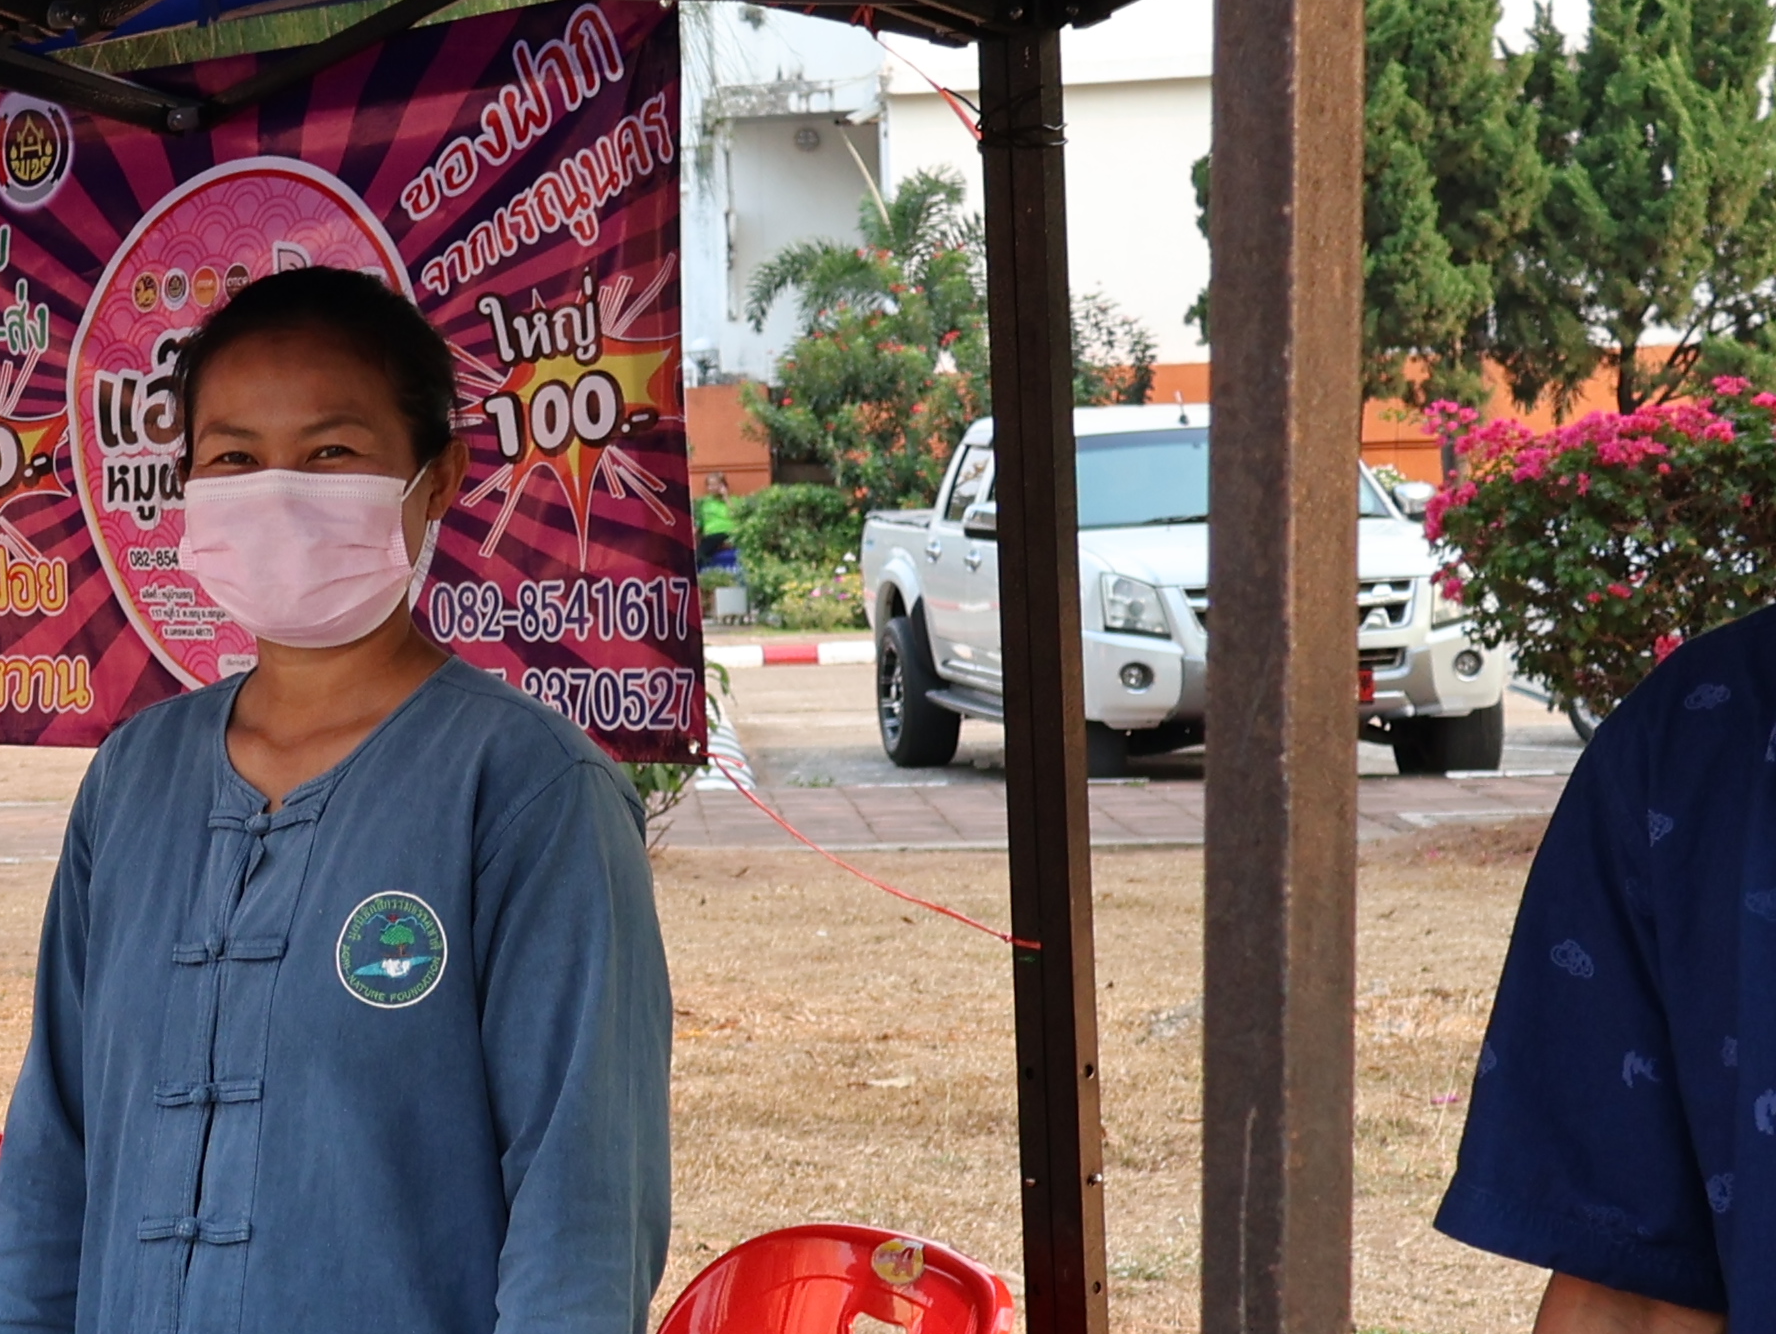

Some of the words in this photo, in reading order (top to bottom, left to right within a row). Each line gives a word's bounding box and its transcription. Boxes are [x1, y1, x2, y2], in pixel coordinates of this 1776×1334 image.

[401, 4, 624, 221] ของฝาก
[422, 94, 674, 295] จากเรณูนคร
[478, 268, 599, 364] ใหญ่
[485, 374, 650, 459] 100.-
[429, 577, 691, 643] 082-8541617
